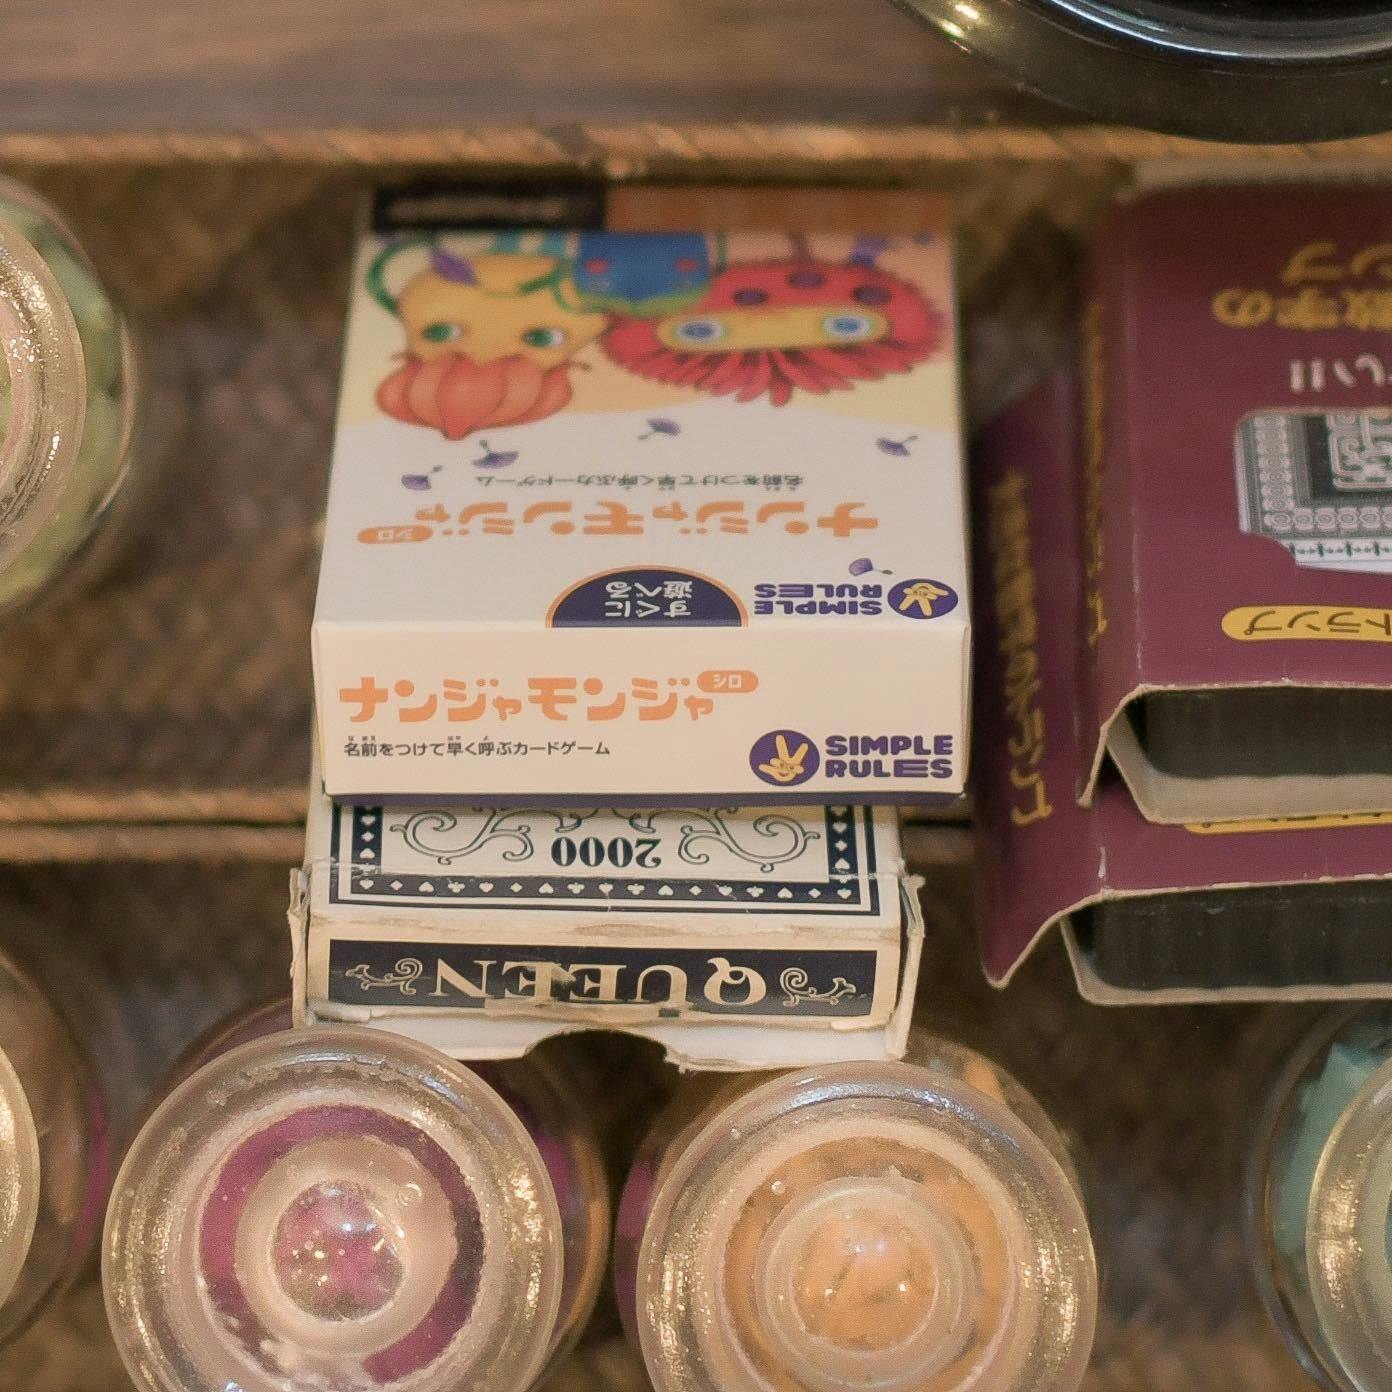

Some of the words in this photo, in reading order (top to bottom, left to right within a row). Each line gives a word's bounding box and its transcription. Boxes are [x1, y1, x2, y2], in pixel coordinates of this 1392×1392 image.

[476, 474, 804, 488] 名前をつけて早く呼ぶカードゲーム
[415, 501, 879, 537] ナンジャモンジャ
[605, 580, 693, 599] 遊べる
[753, 582, 883, 598] RULES
[605, 599, 692, 618] すぐに
[753, 599, 883, 616] SIMPLE
[712, 673, 743, 689] シロ
[339, 676, 714, 722] ナンジャモンジャ
[344, 741, 611, 757] 名前をつけて早く呼ぶカードゲーム
[824, 735, 953, 756] SIMPLE
[824, 759, 953, 779] RULES
[551, 836, 662, 868] 2000
[428, 956, 768, 1007] QUEEN
